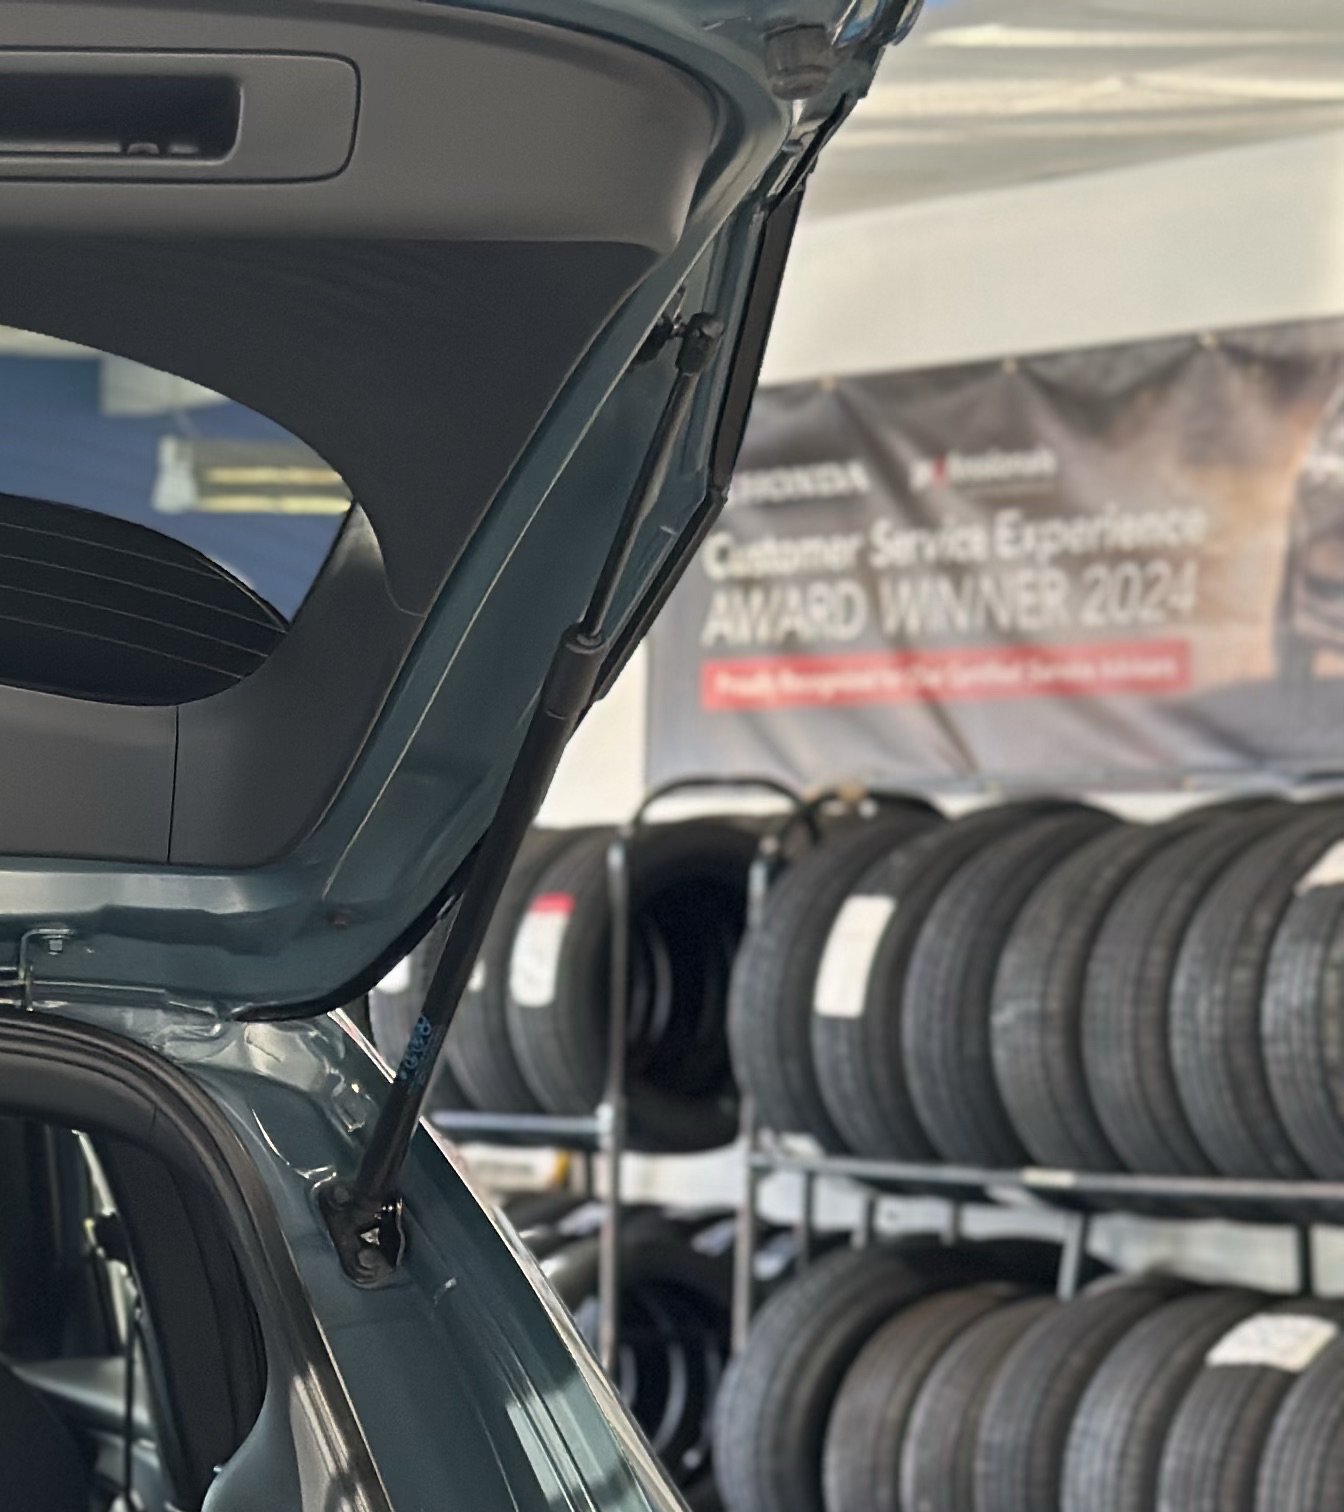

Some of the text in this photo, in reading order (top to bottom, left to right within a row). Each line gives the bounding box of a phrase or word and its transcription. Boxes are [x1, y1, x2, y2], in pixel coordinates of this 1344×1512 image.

[703, 504, 1206, 580] Customer Service Experience
[701, 560, 1199, 648] AWARD WINNER 2024
